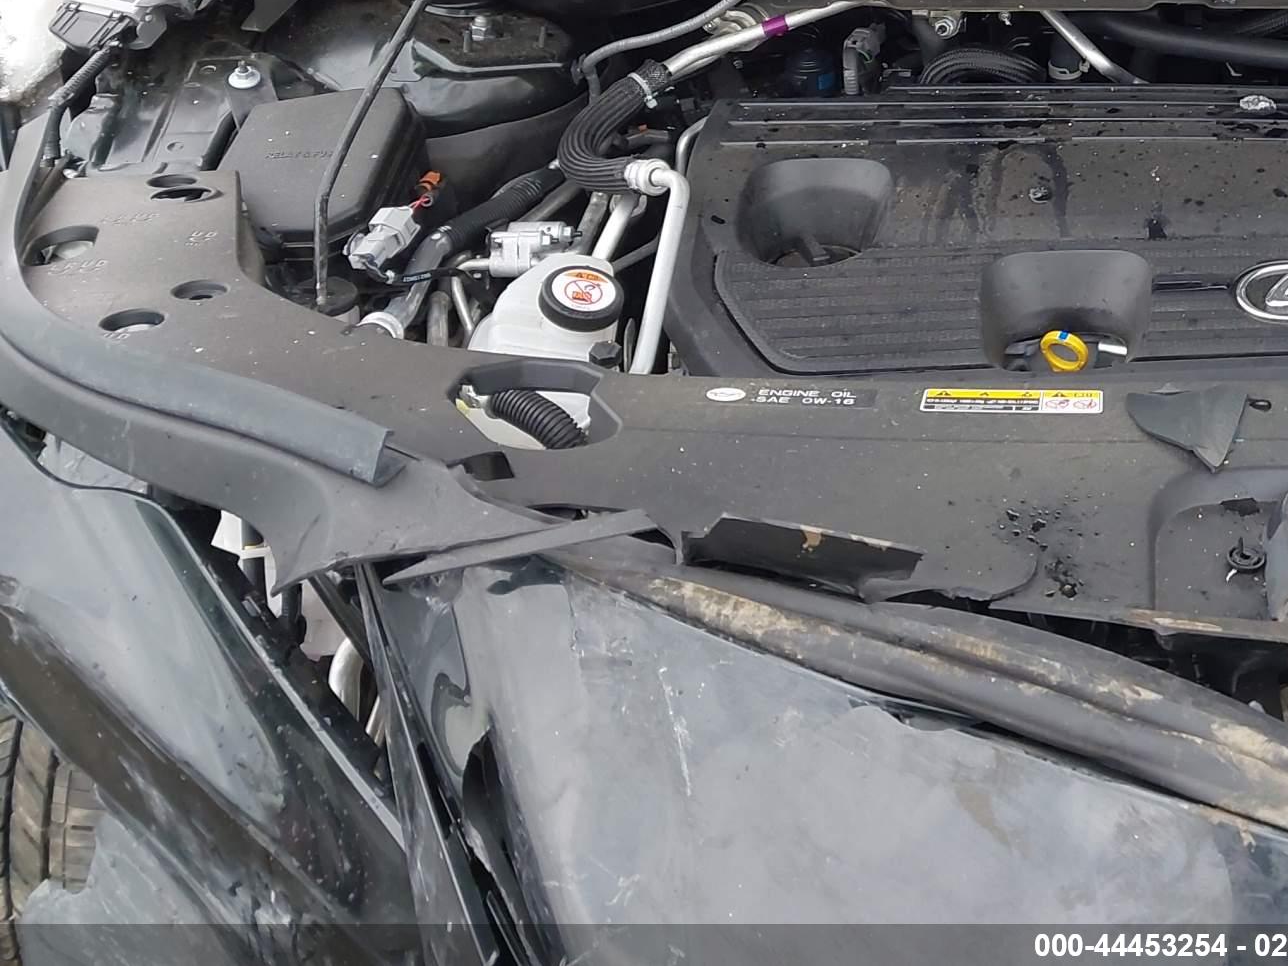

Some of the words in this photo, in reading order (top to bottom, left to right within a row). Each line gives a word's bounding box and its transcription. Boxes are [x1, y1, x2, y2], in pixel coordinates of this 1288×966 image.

[758, 389, 820, 397] ENGINE
[831, 389, 857, 398] OIL
[802, 397, 855, 405] 0W-16
